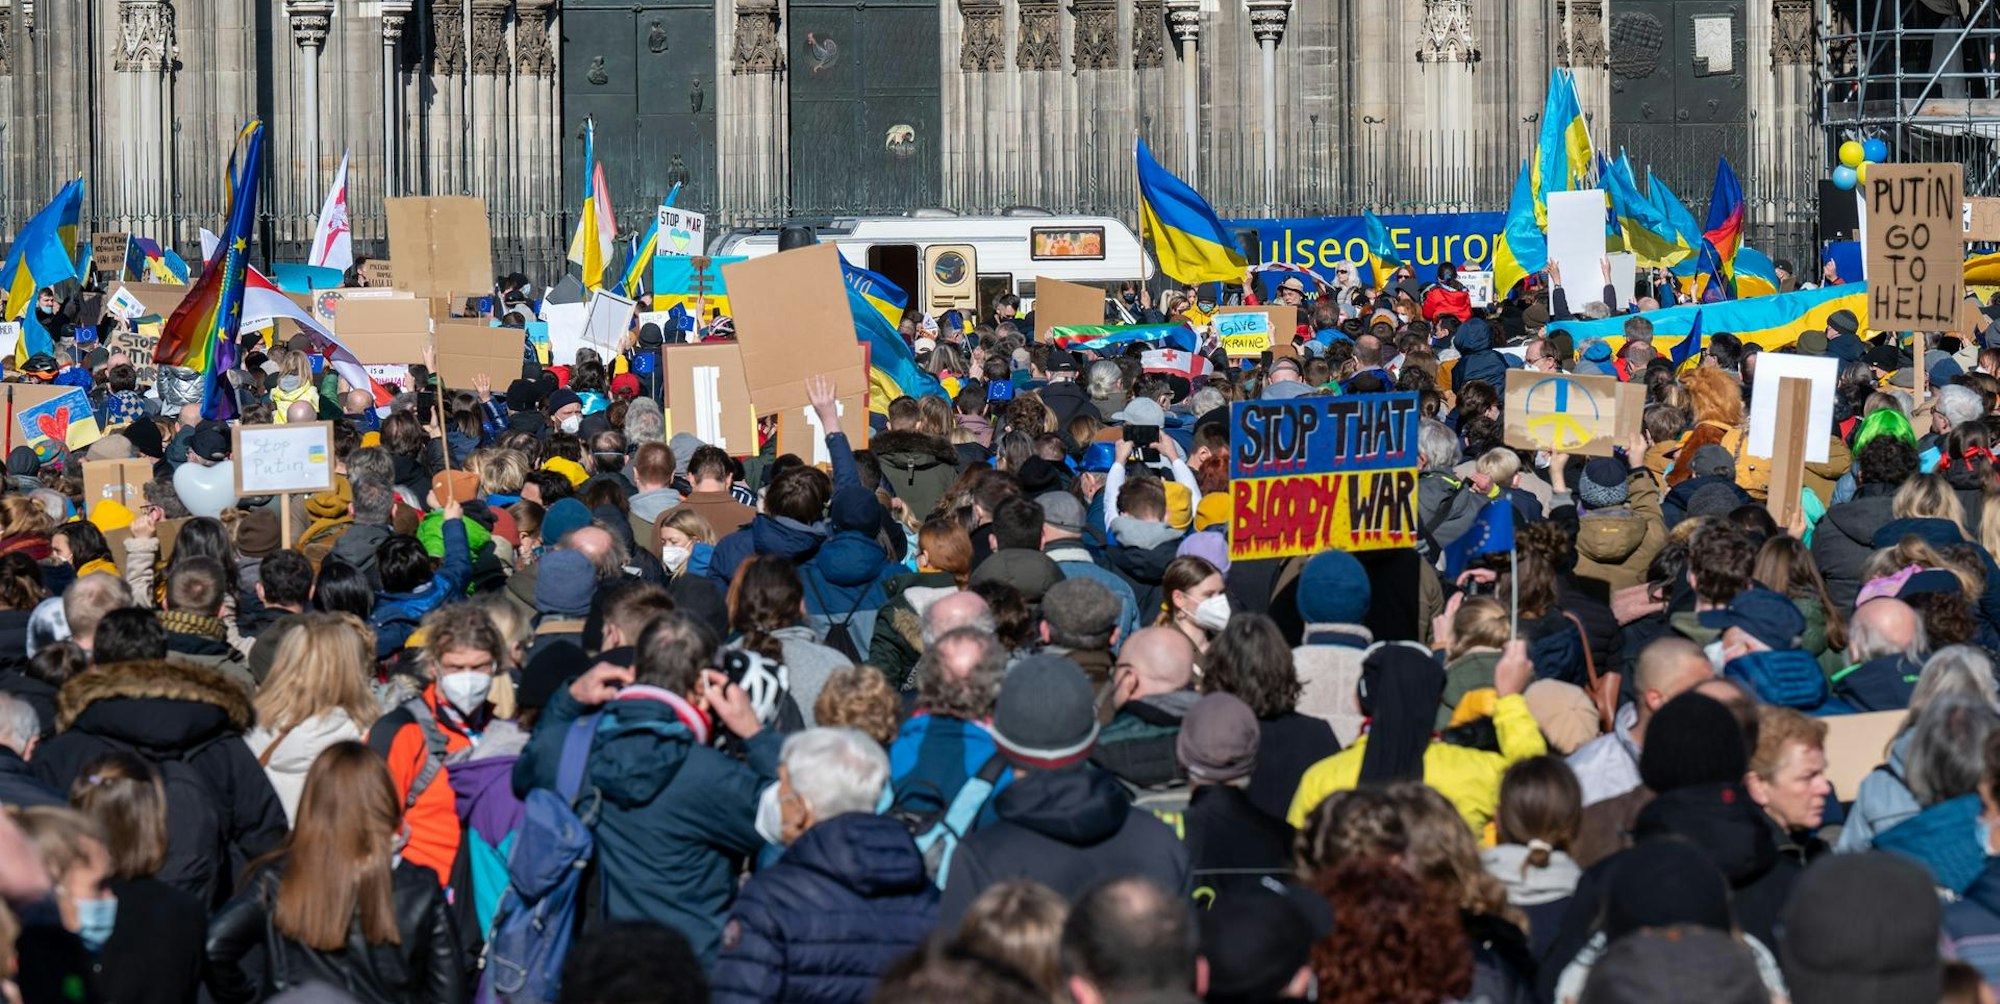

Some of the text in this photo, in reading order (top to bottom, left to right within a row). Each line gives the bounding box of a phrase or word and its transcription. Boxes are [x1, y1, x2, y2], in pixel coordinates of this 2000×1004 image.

[660, 211, 701, 232] STOP WAR
[1886, 223, 1930, 250] GO
[1884, 255, 1926, 286] TO
[1875, 284, 1956, 325] HELL!
[118, 333, 159, 351] STOP
[253, 437, 290, 457] Stop
[1238, 399, 1417, 469] STOP THAT
[254, 457, 303, 475] Putin
[1232, 471, 1418, 549] BLOODY WAR
